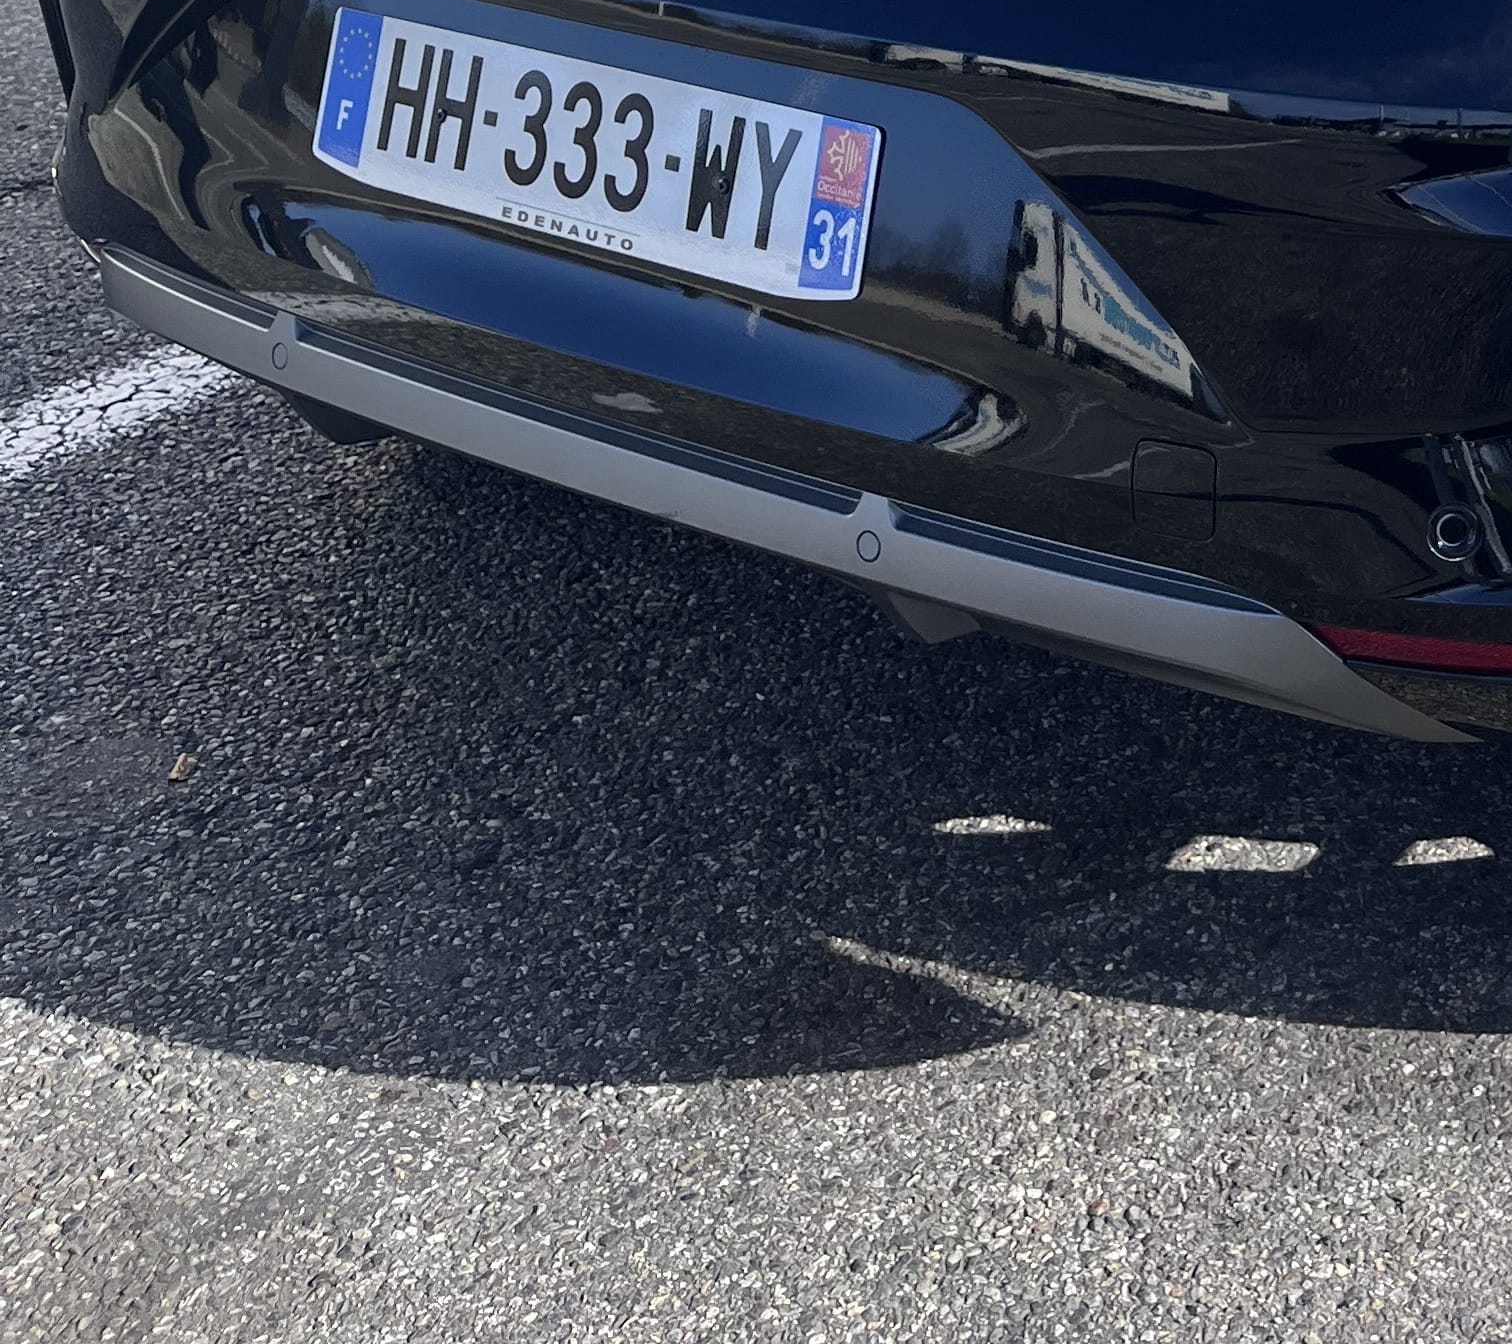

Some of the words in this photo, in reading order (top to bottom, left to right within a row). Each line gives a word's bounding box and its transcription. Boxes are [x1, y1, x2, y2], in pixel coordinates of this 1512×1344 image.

[335, 98, 354, 131] F
[376, 37, 803, 251] HH-333-WY
[501, 205, 634, 251] EDENAUTO
[808, 209, 857, 277] 31
